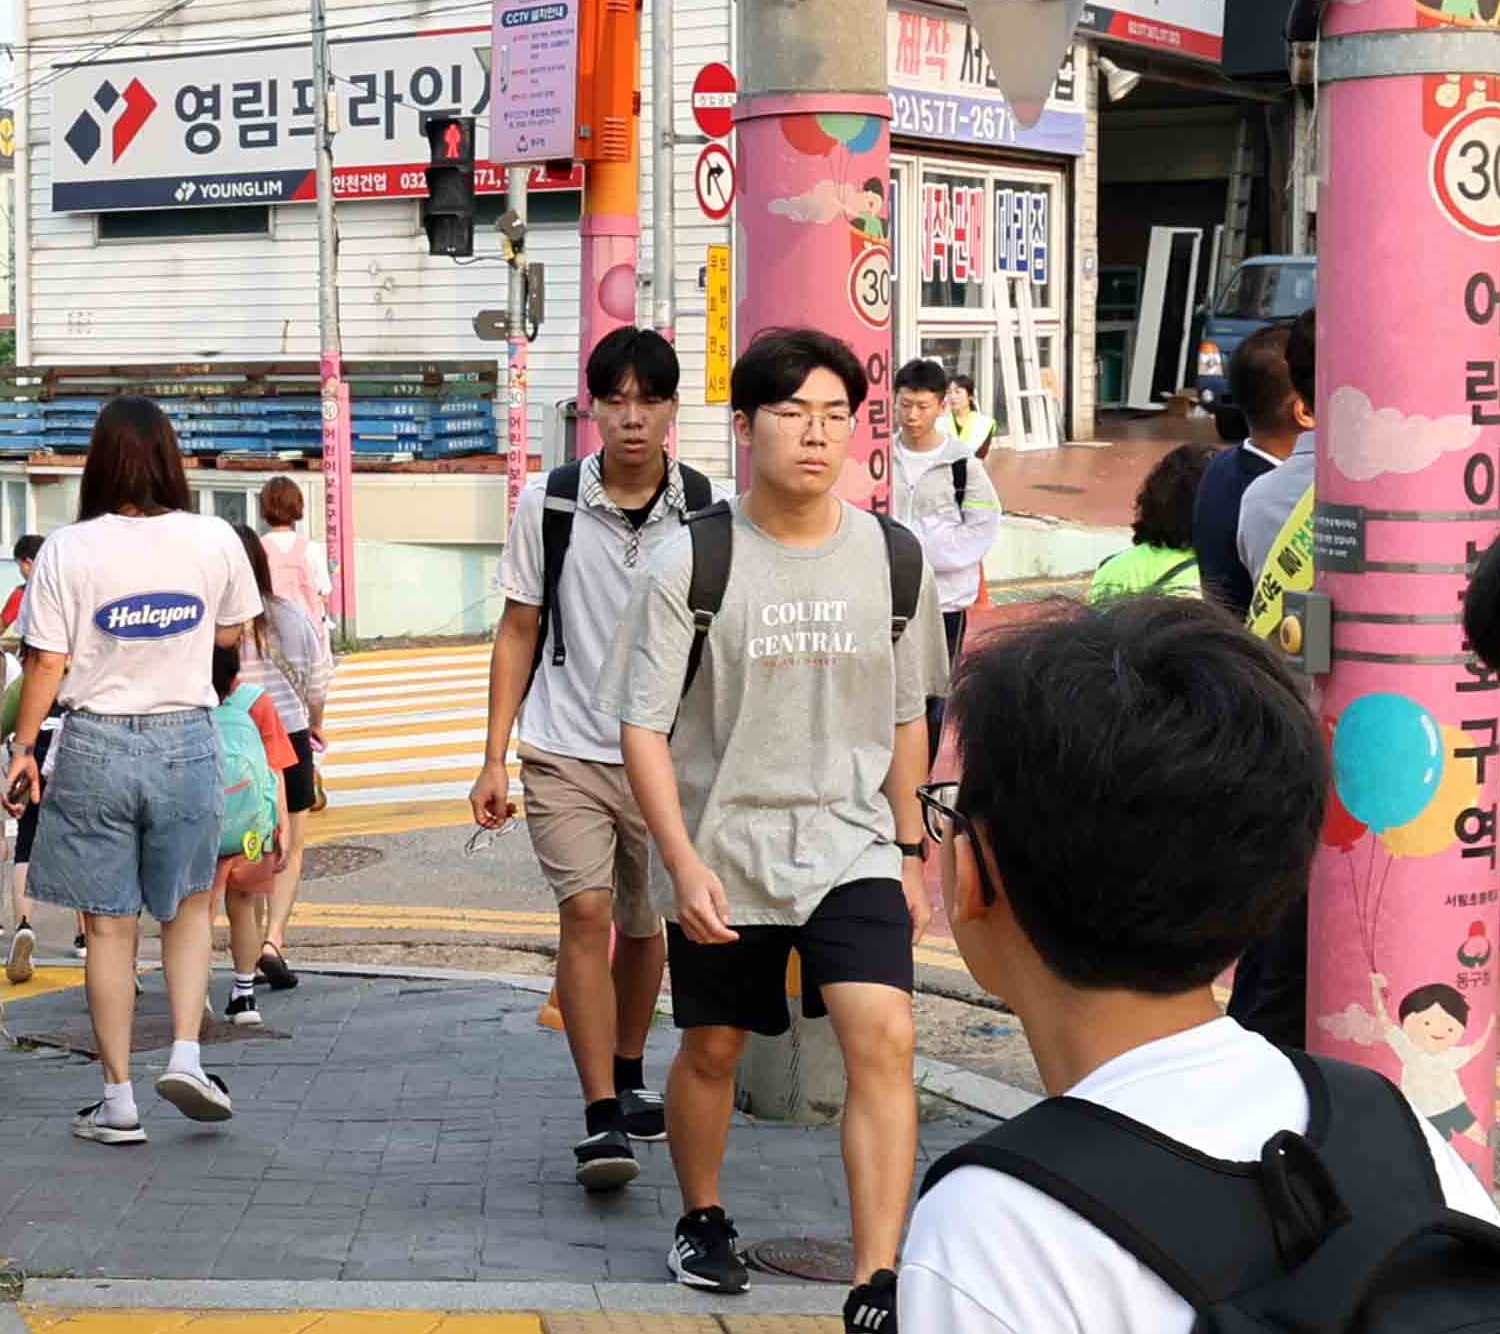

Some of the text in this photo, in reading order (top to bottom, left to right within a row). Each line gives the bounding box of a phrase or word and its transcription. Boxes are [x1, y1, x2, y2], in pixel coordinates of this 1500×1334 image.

[505, 9, 528, 25] CCTV
[175, 64, 491, 155] 영림프라임
[199, 180, 283, 200] YOUNGLIM
[332, 172, 388, 194] 인천건업
[862, 269, 890, 307] 30
[107, 603, 198, 629] Halcyon
[761, 600, 847, 627] COURT
[748, 630, 857, 659] CENTRAL
